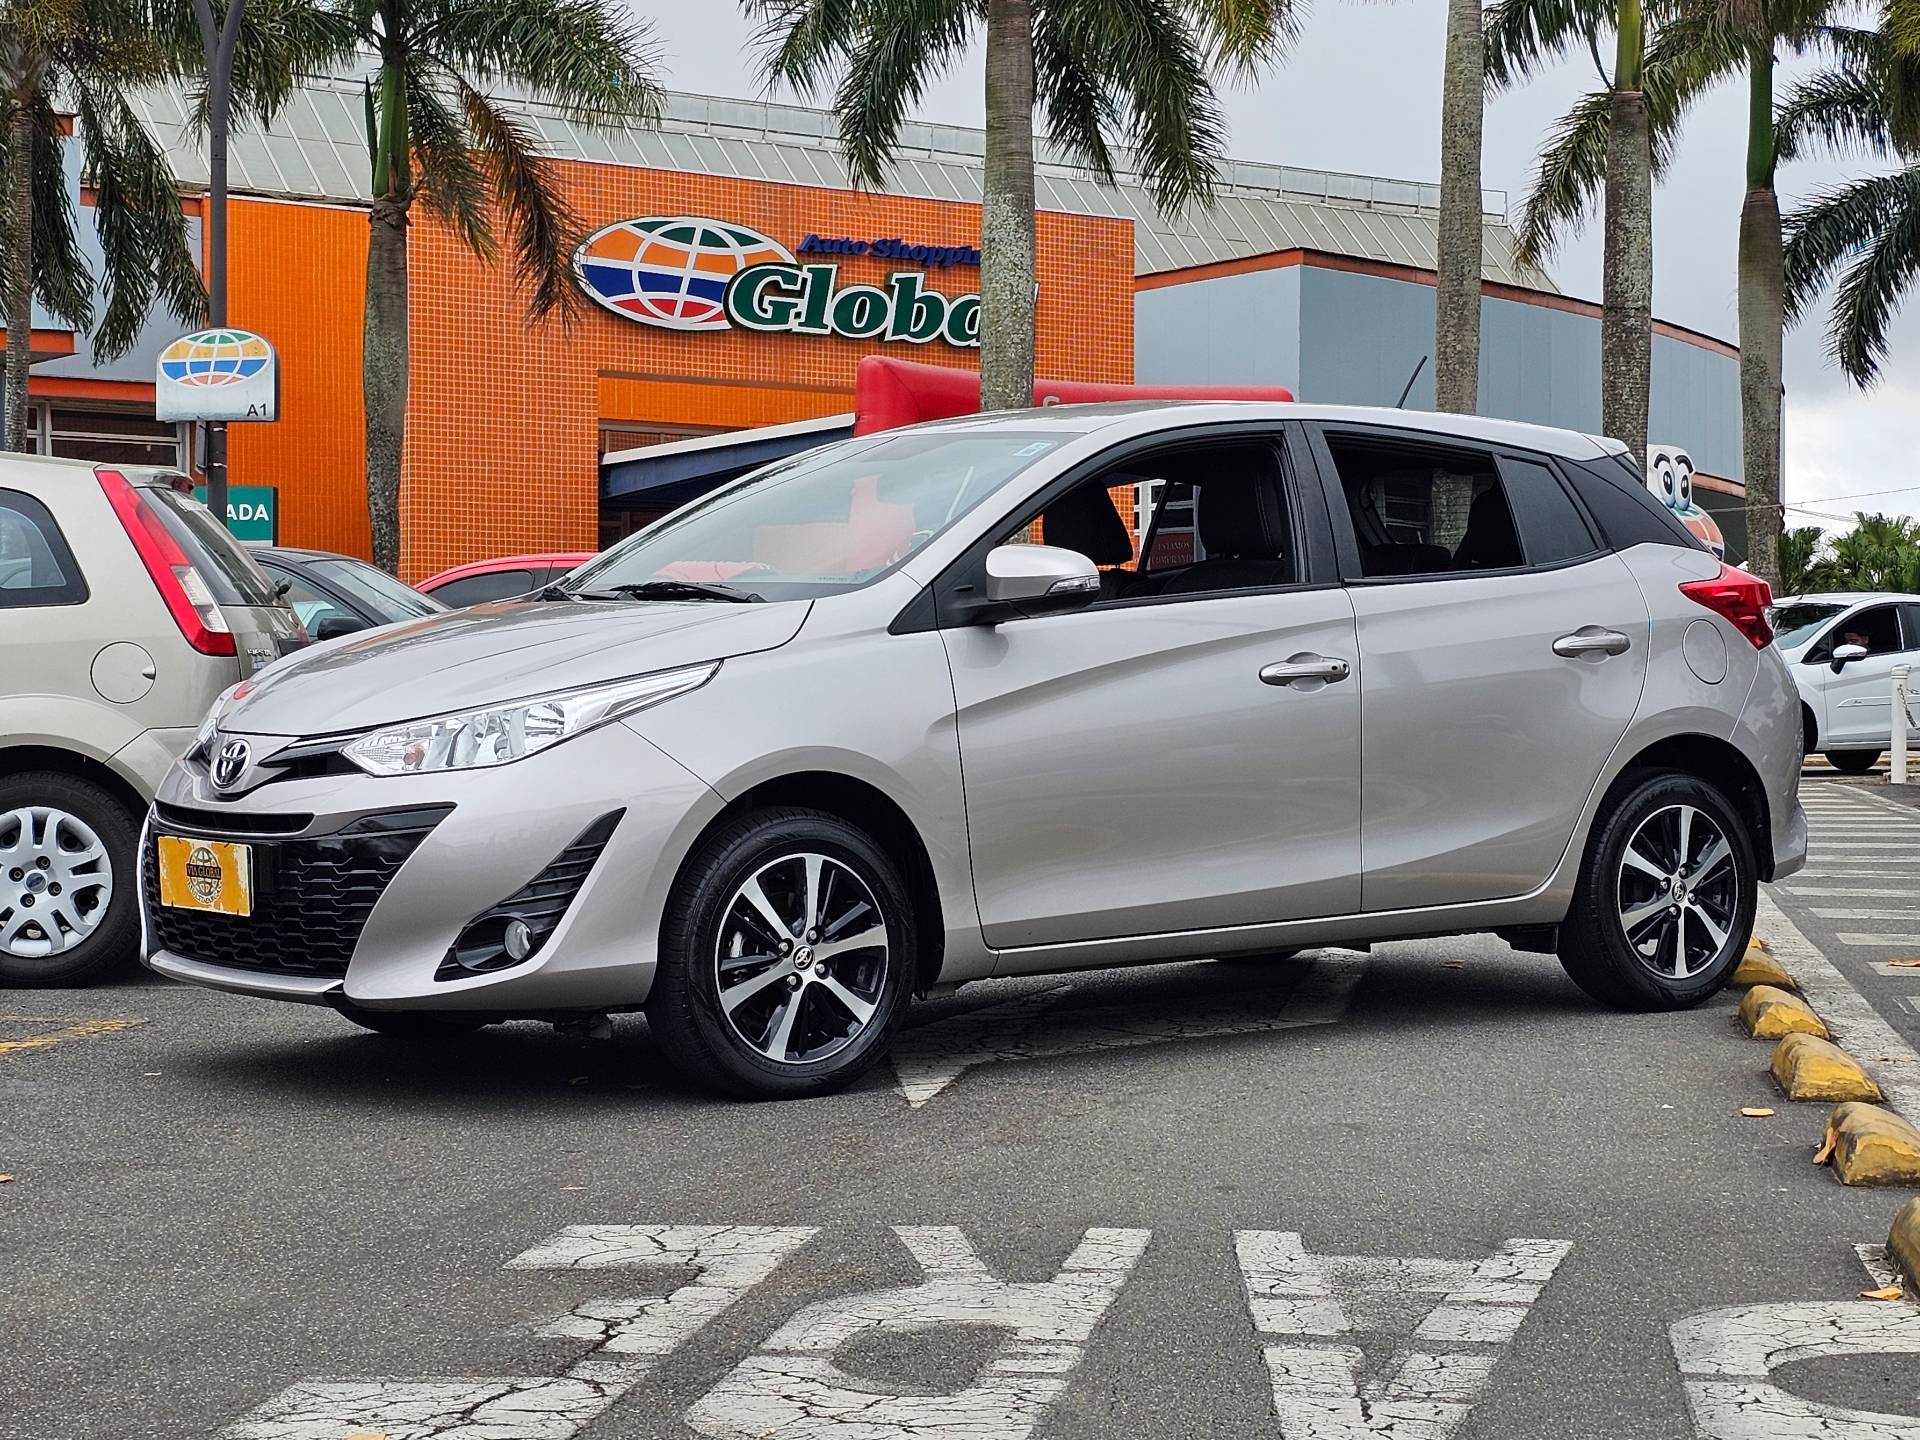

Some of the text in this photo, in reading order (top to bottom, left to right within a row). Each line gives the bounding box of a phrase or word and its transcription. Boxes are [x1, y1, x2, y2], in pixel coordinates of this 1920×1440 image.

[798, 233, 980, 266] Auto Shoppi
[724, 263, 1039, 347] Globa
[247, 403, 267, 417] A1
[227, 503, 269, 521] ADA
